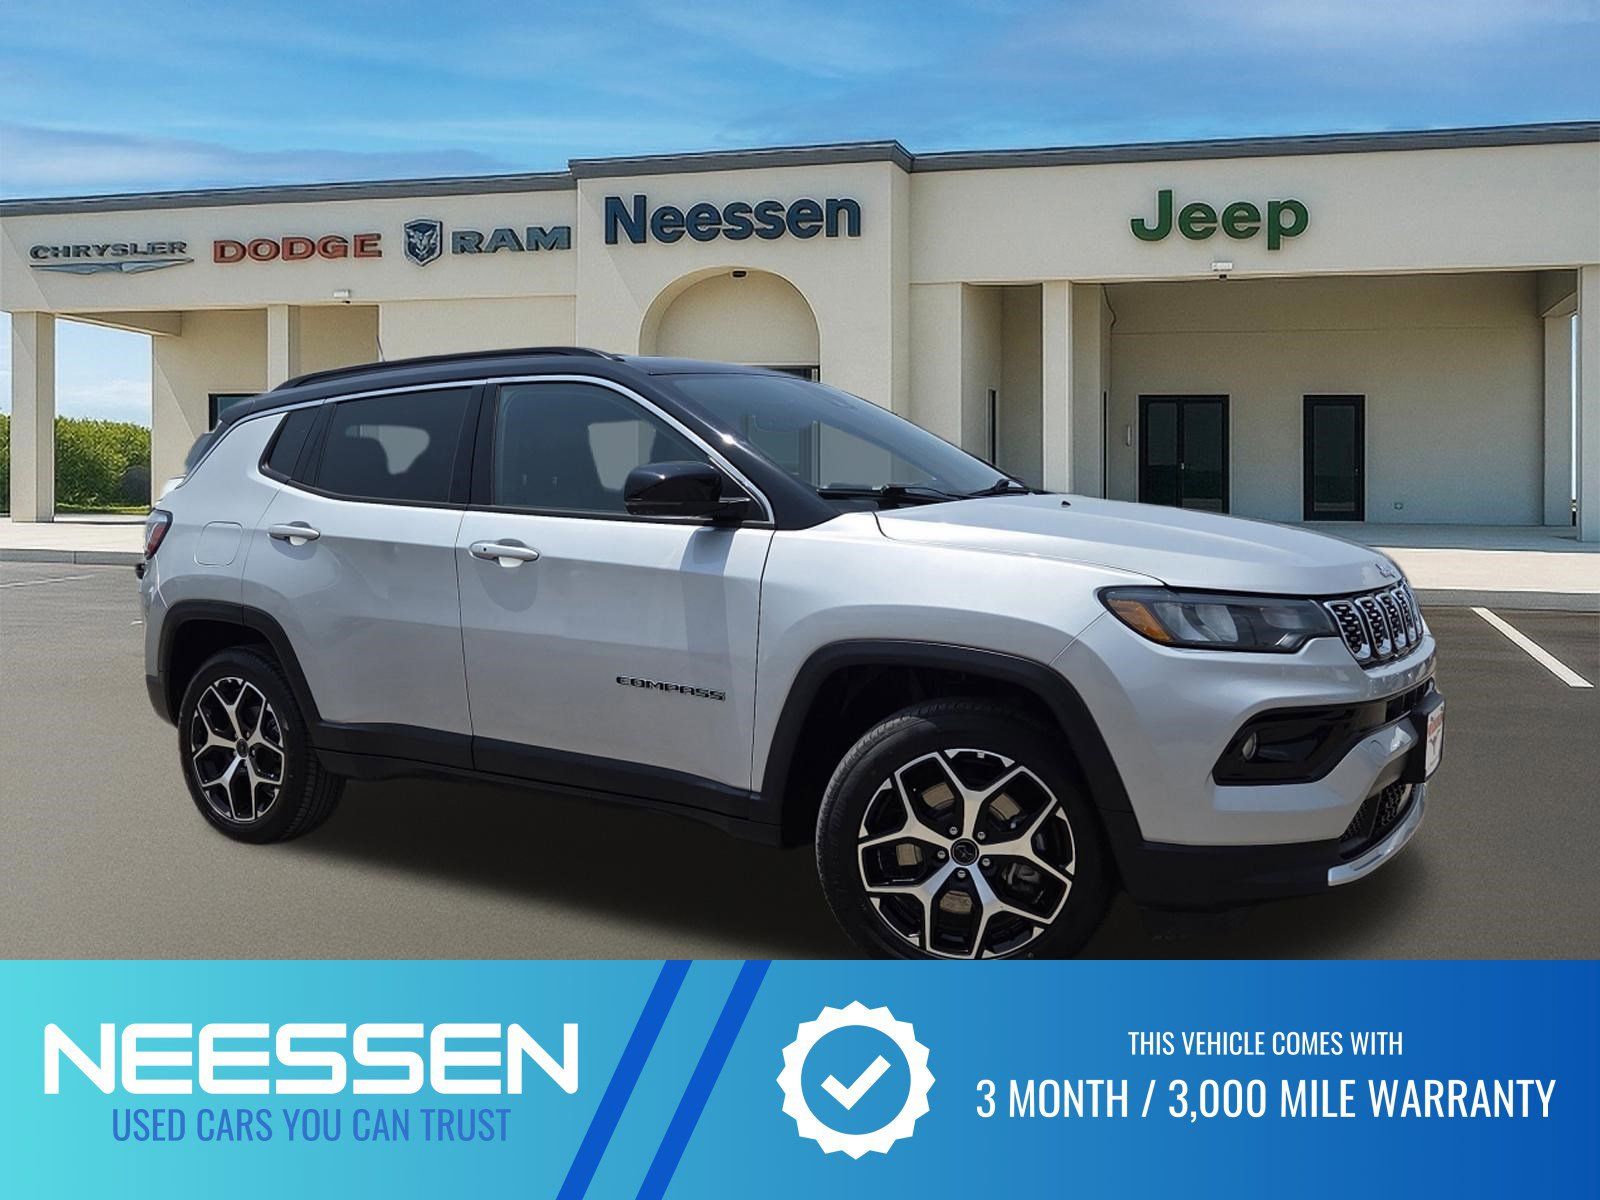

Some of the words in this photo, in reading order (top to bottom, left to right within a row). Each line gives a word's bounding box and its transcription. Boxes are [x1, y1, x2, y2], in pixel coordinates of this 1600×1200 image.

[604, 194, 862, 245] Neessen
[1130, 189, 1309, 250] Jeep
[29, 240, 189, 259] CHRYSLER
[212, 232, 383, 265] DODGE
[451, 225, 572, 255] RAM
[616, 675, 726, 701] COMPASS
